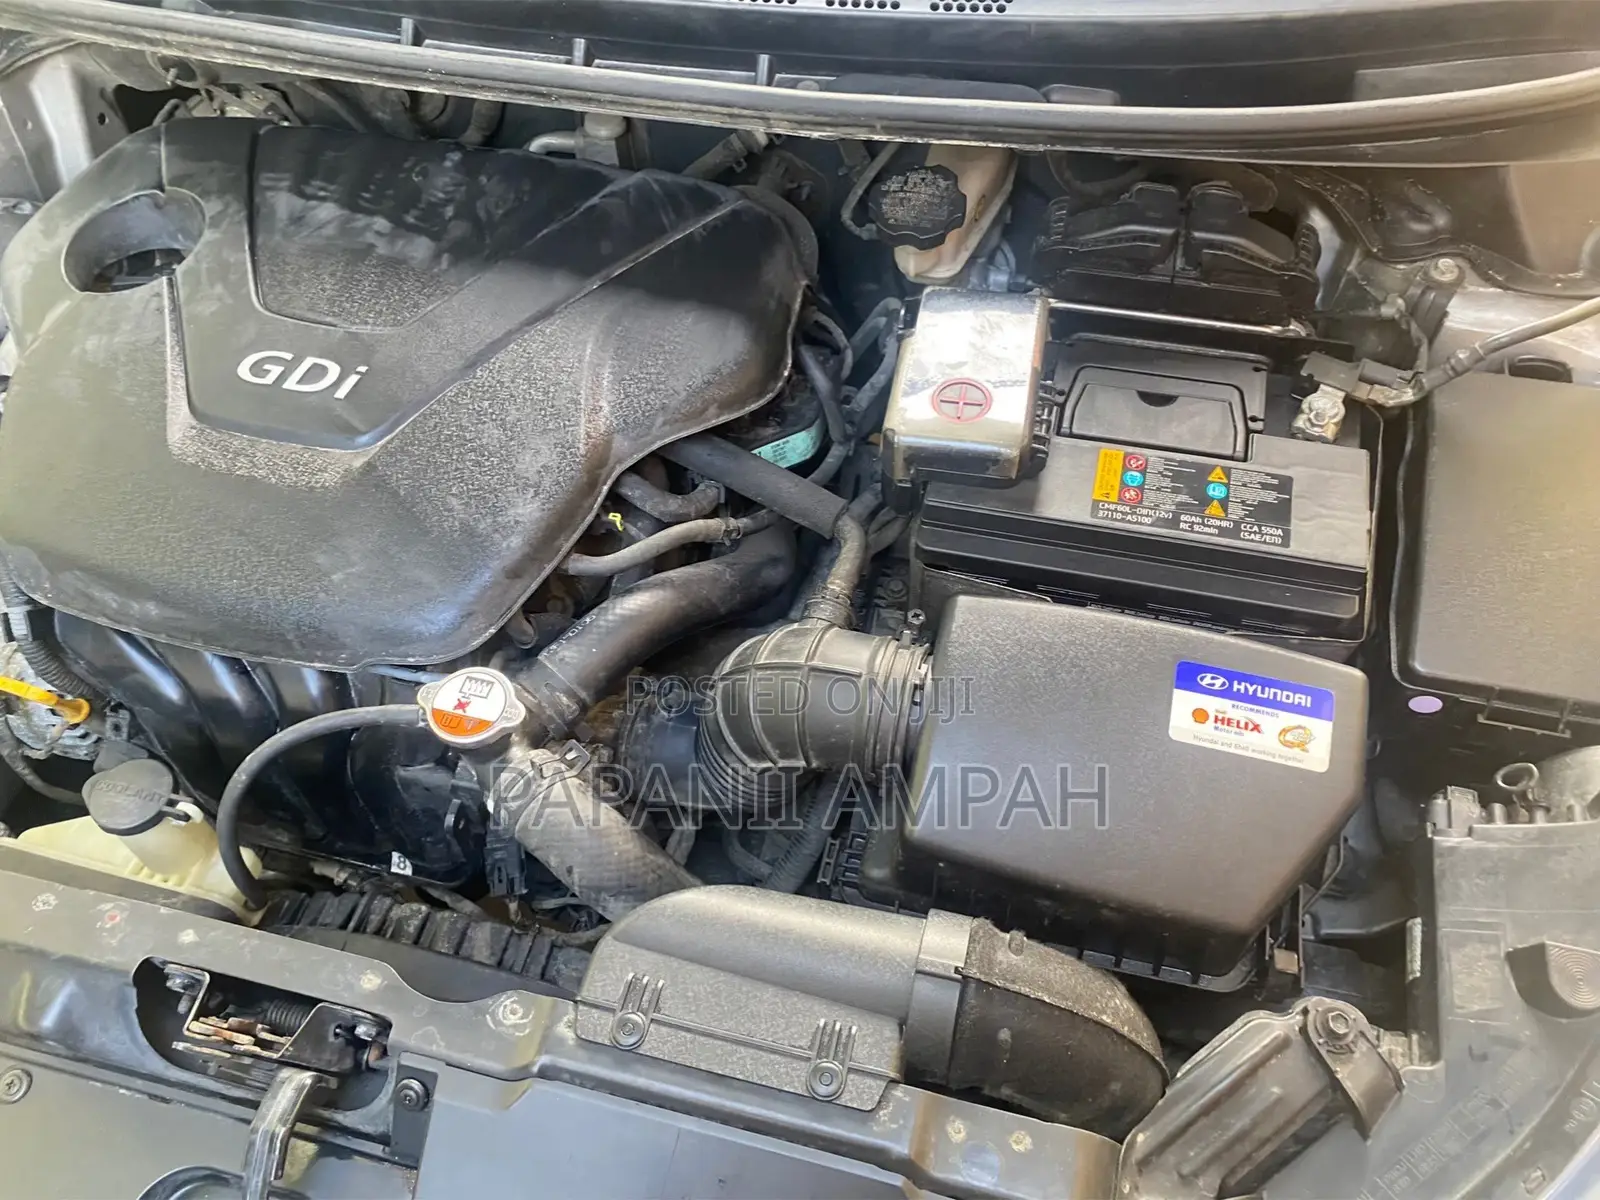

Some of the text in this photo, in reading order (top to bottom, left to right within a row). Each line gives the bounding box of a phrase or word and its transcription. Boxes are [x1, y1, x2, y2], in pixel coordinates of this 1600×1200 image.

[237, 351, 369, 400] GDi
[1179, 522, 1192, 531] RC
[1180, 514, 1234, 528] 60Ah (20HR)
[1241, 523, 1284, 537] CCA 550A
[1233, 680, 1312, 708] HYUNDAI
[1231, 703, 1280, 719] RECOMMENDS
[1213, 715, 1264, 734] HELIX
[1213, 725, 1232, 735] Motor
[95, 780, 165, 803] COOLANT
